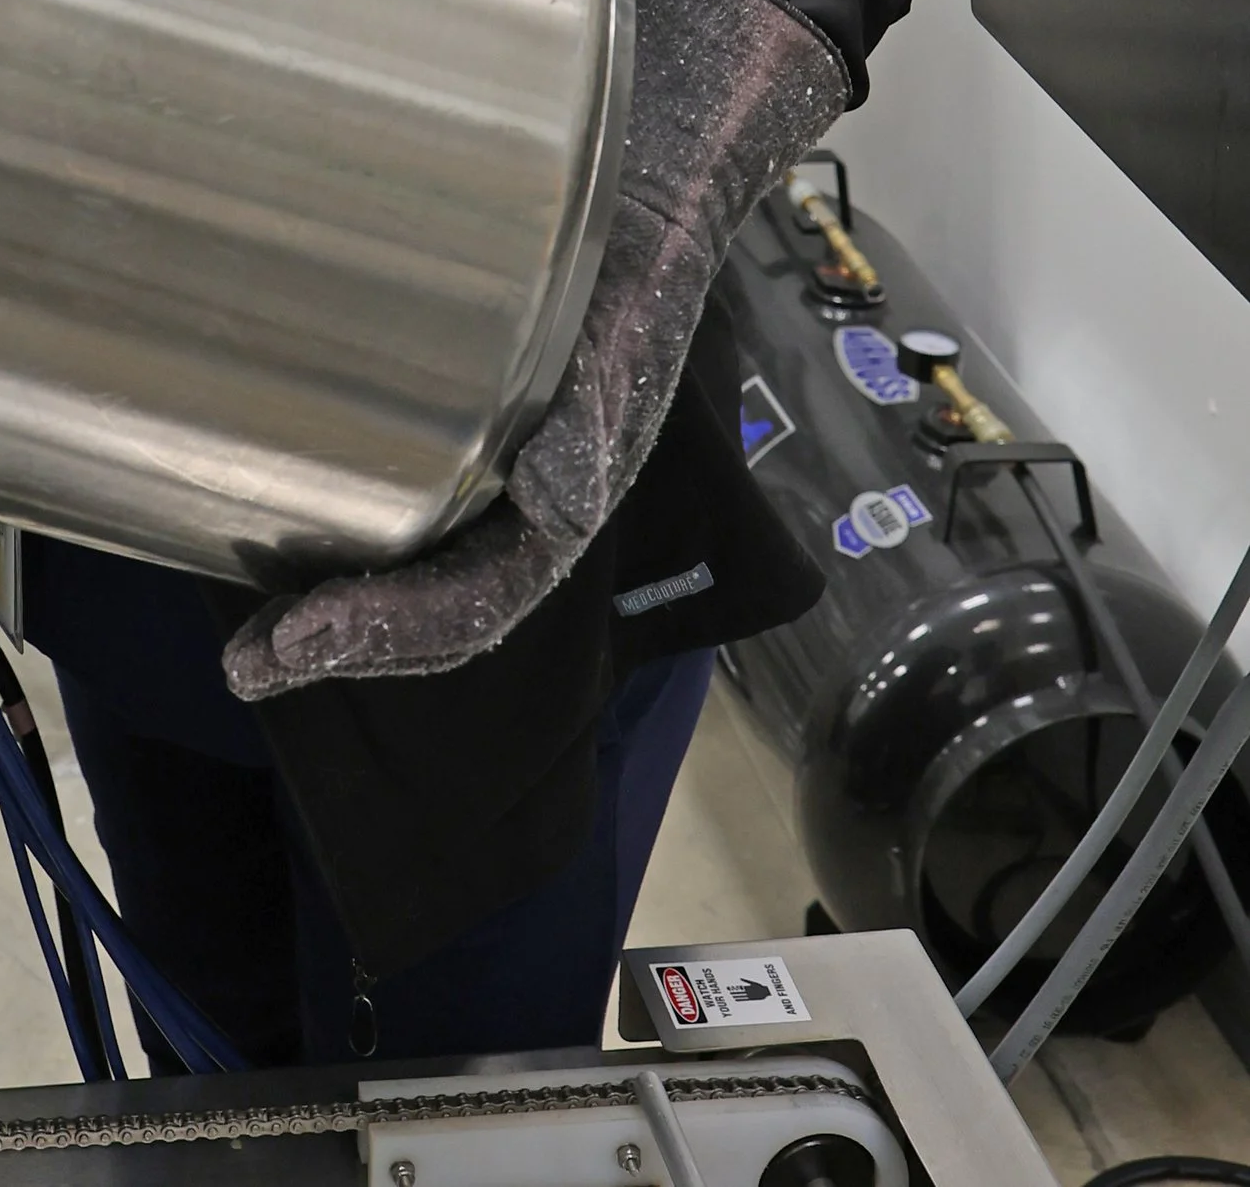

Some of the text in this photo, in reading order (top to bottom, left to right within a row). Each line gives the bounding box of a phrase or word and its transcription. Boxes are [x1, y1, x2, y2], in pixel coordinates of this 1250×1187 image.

[666, 974, 696, 1015] DANGER
[695, 979, 716, 1008] WATCH
[702, 968, 733, 1018] YOUR HANDS
[764, 964, 797, 1015] AND FINGERS
